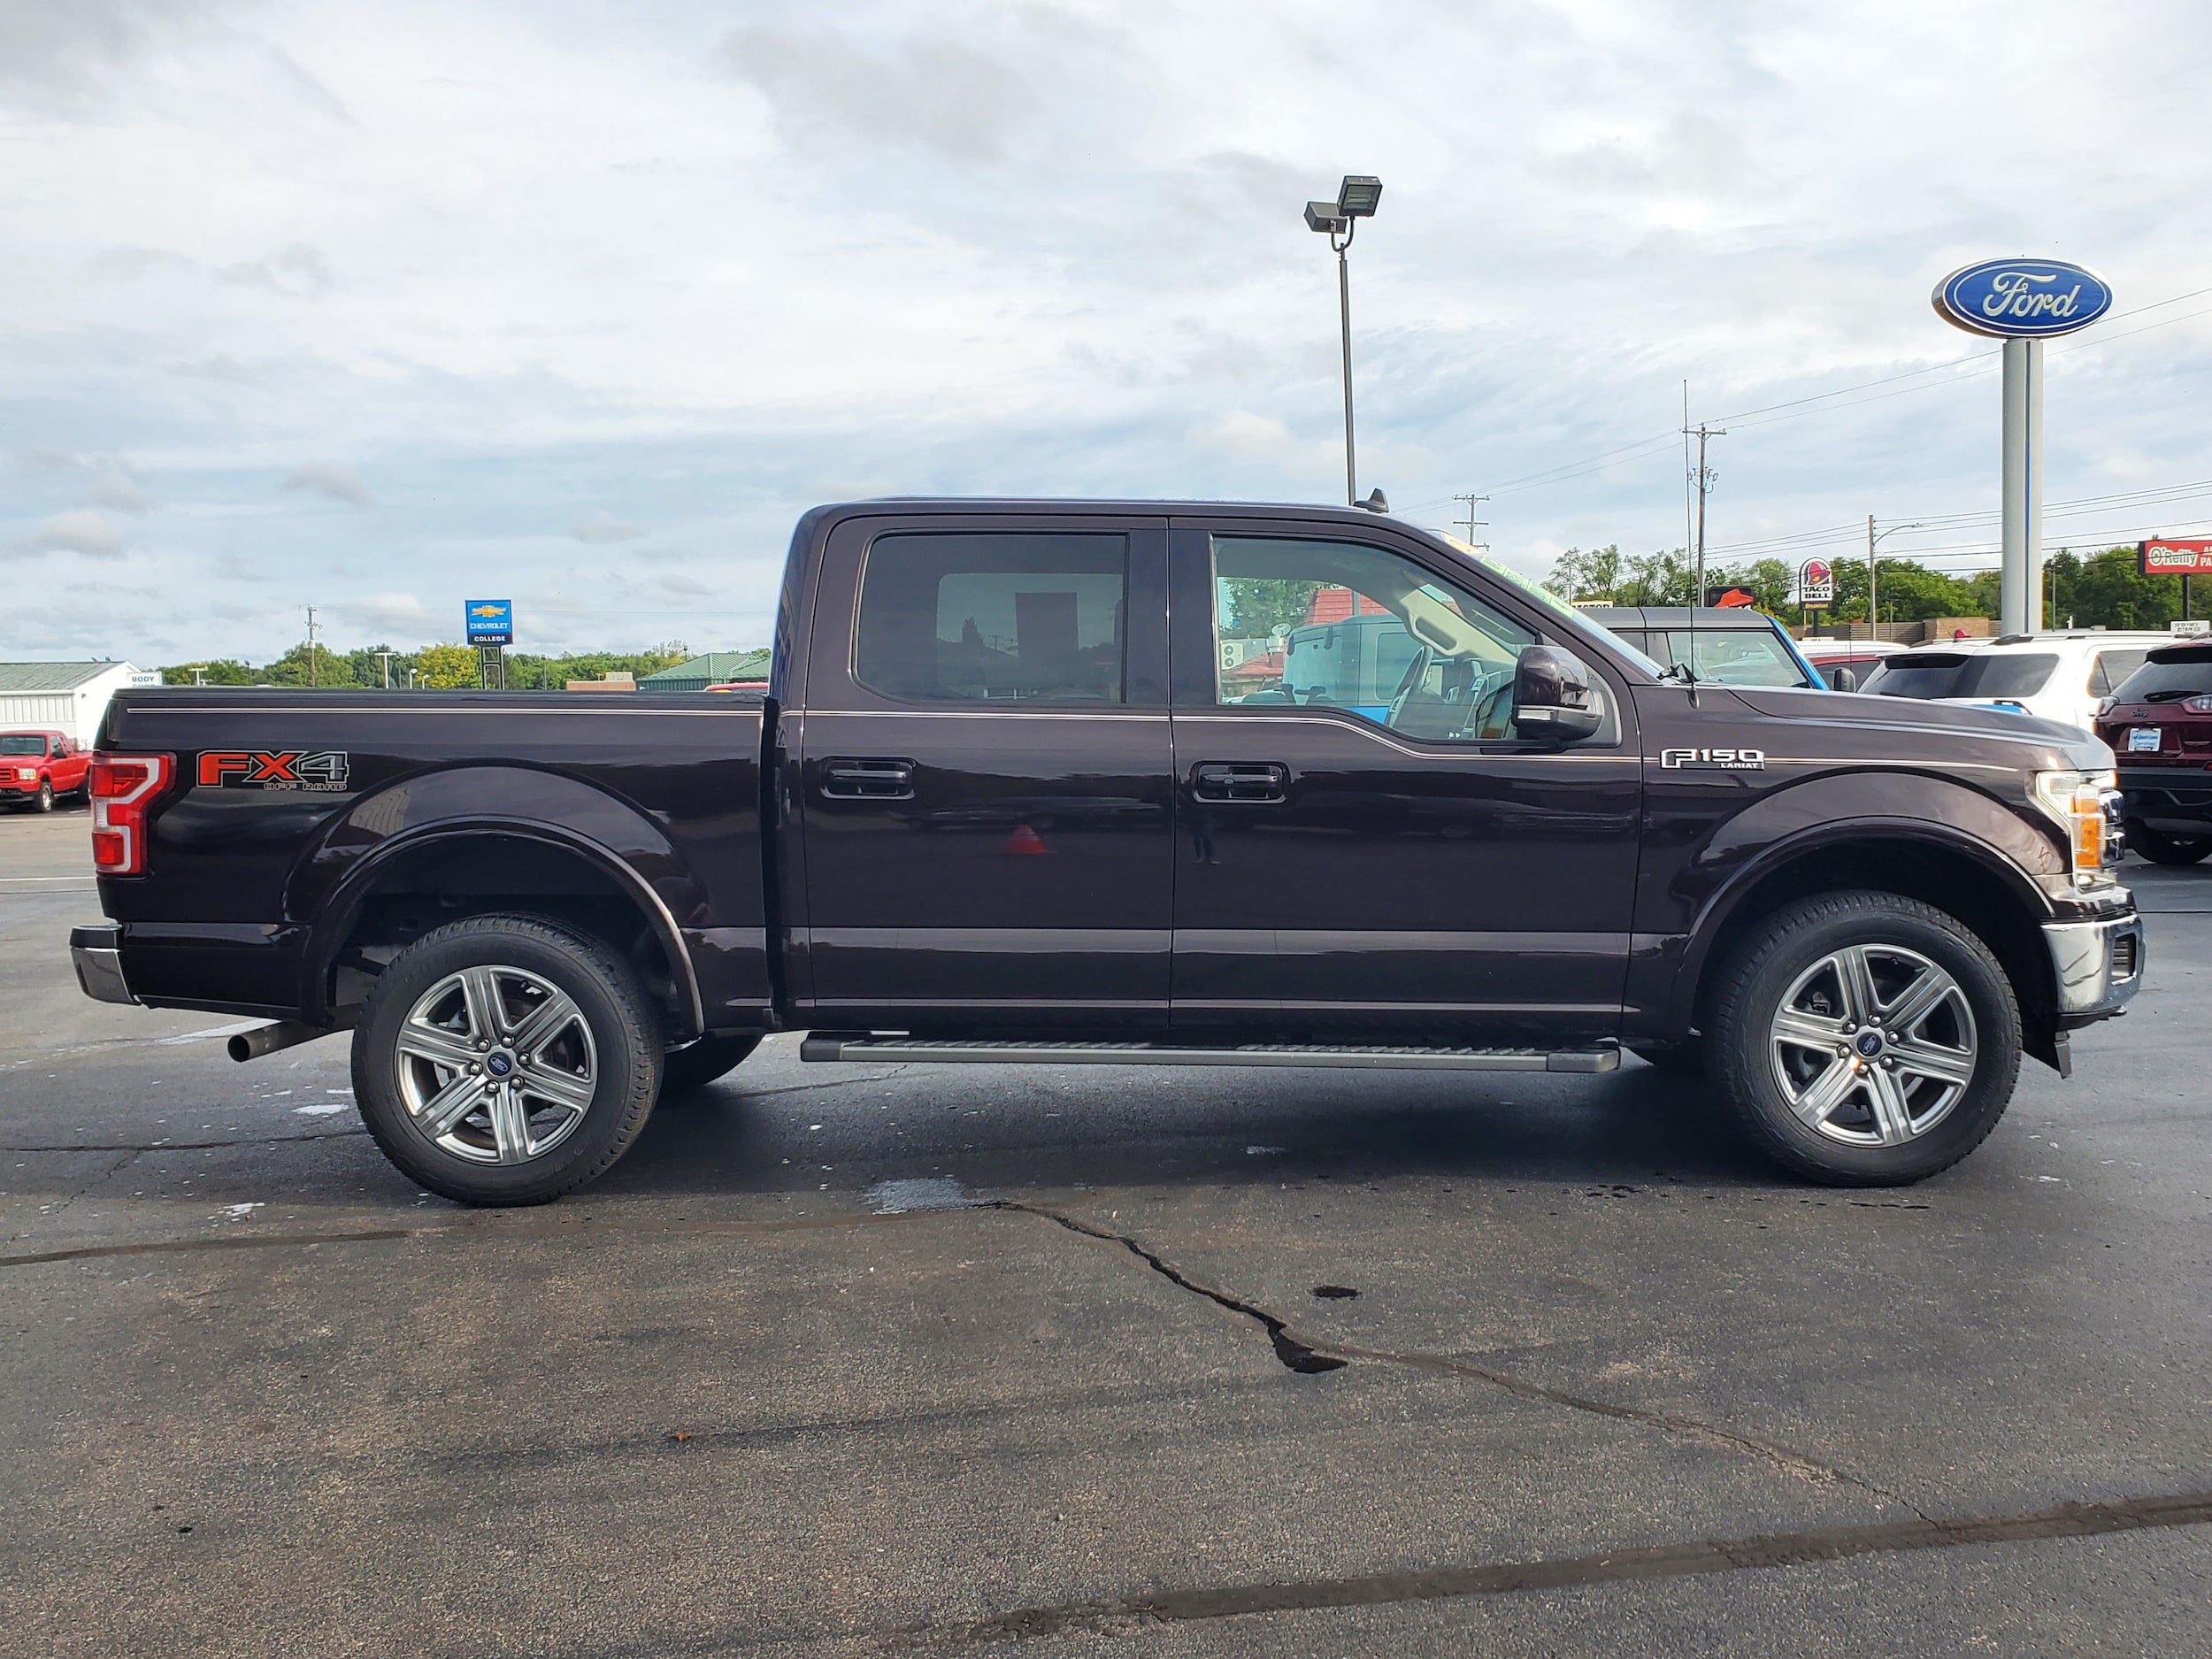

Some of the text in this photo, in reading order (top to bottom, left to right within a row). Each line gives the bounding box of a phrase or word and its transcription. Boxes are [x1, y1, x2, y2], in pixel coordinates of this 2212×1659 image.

[1982, 272, 2082, 318] Ford
[2148, 546, 2198, 567] O'Reilly
[196, 750, 349, 787] FX4
